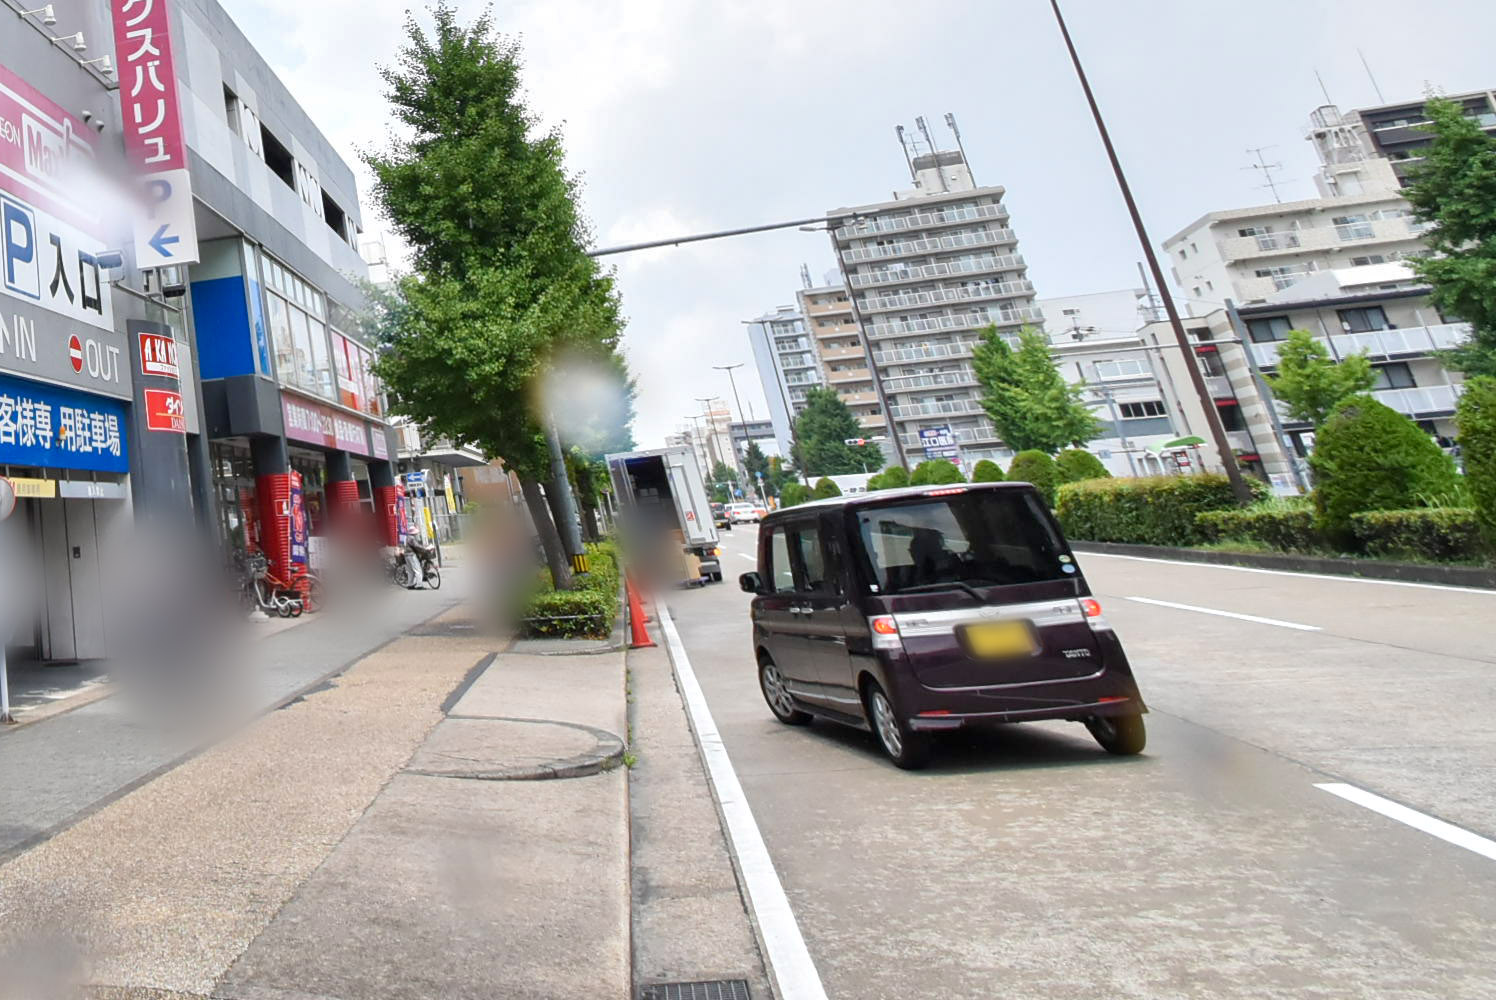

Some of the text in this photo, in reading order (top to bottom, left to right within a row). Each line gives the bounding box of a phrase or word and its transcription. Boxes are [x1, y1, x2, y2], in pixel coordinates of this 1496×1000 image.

[48, 231, 104, 317] 入口
[13, 313, 37, 363] IN
[85, 338, 120, 384] OUT
